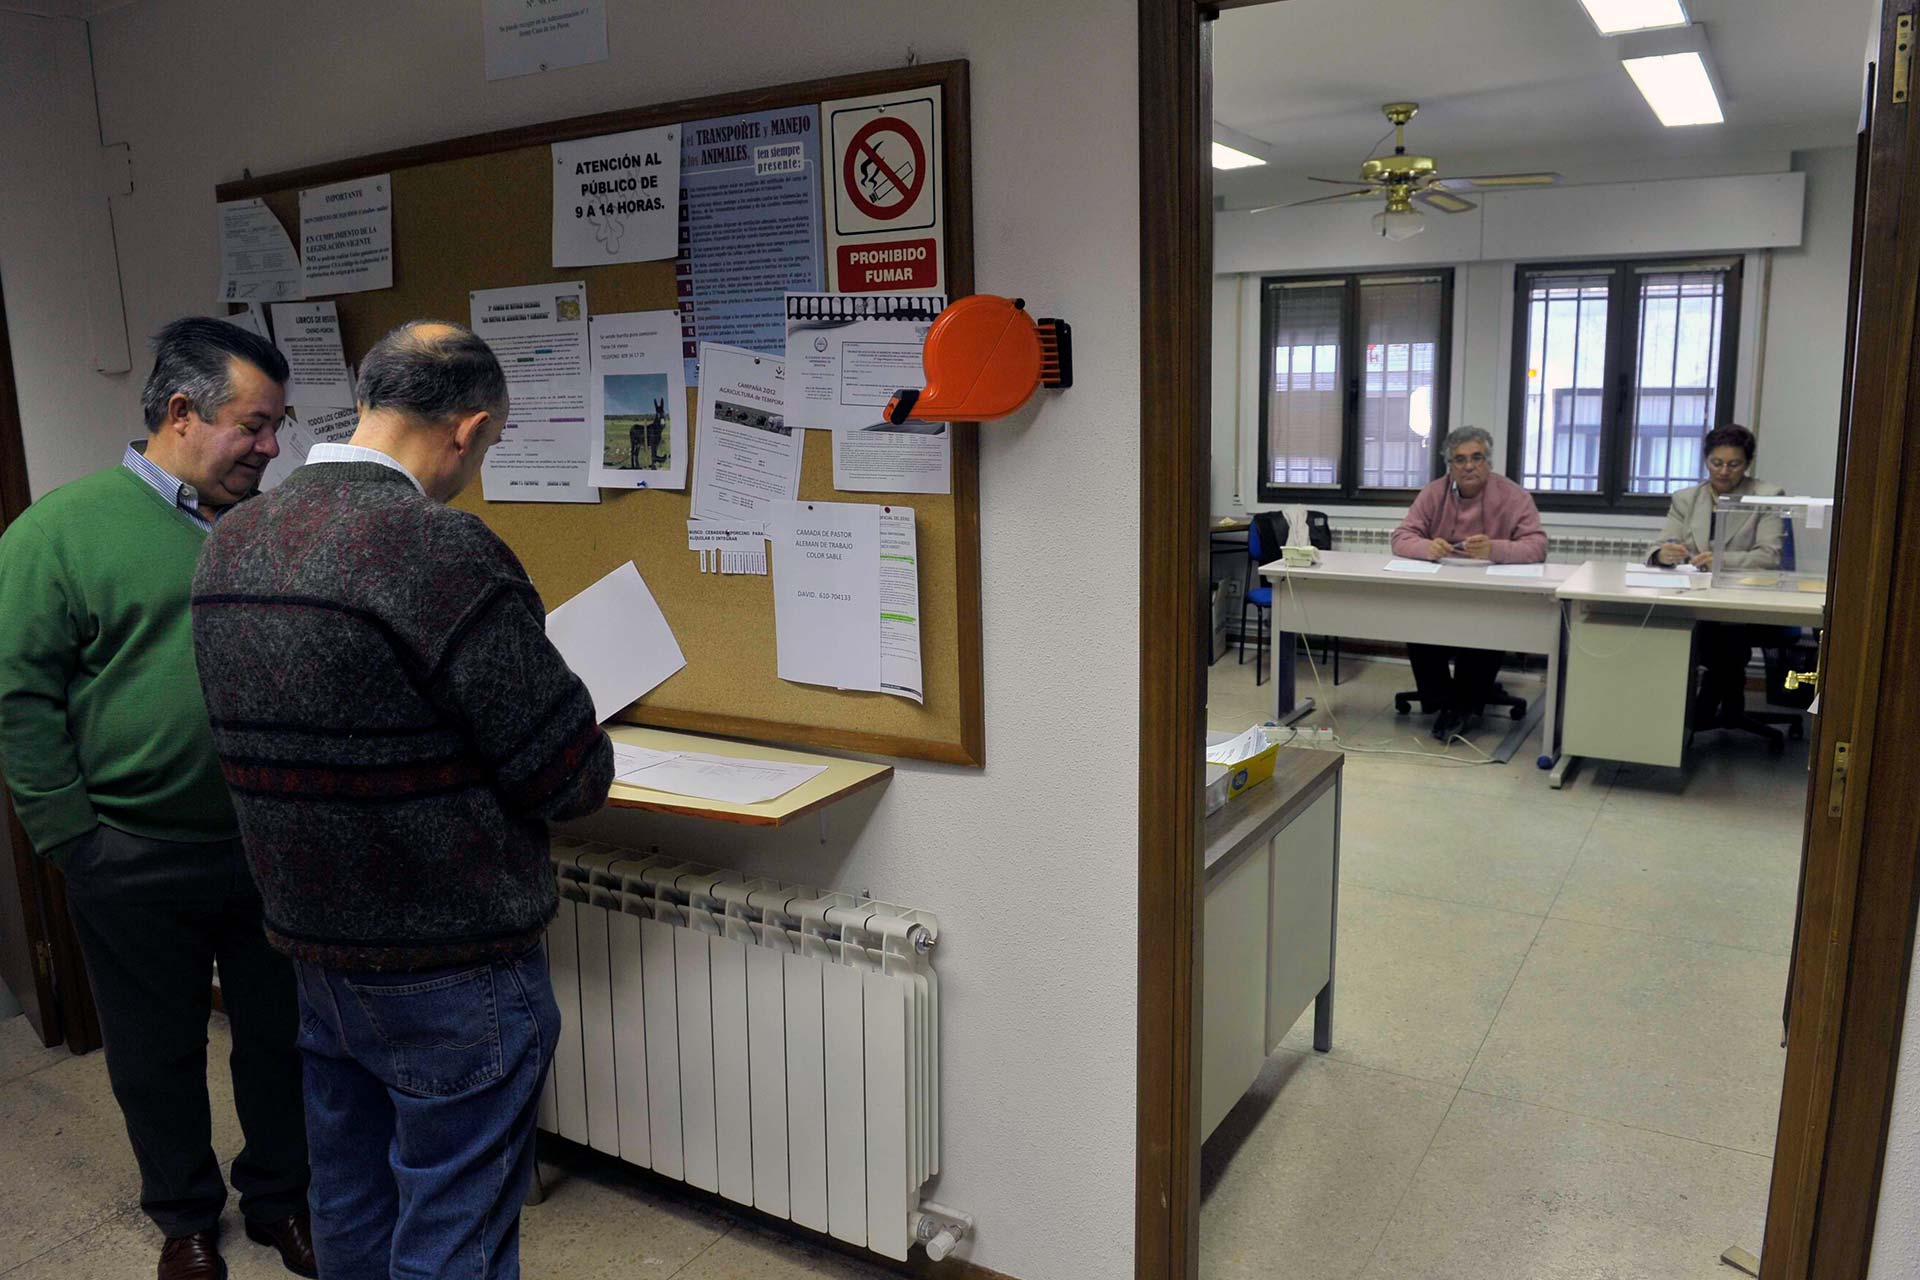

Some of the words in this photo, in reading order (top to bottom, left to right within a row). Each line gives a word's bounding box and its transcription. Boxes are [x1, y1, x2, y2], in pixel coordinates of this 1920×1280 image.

[696, 122, 761, 146] TRANSPORTE
[771, 115, 811, 136] MANEJO
[757, 148, 770, 160] ten
[770, 144, 800, 158] siempre
[575, 153, 640, 175] ATENCIÓN
[645, 152, 662, 166] AL
[757, 159, 801, 174] presente:
[581, 178, 637, 196] PÚBLICO
[641, 176, 658, 189] DE
[325, 189, 363, 204] IMPORTANTE
[575, 206, 583, 218] 9
[587, 205, 596, 217] A
[599, 203, 614, 216] 14
[618, 197, 665, 214] HORAS.
[369, 225, 377, 234] LA
[850, 247, 927, 265] PROHIBIDO
[865, 267, 913, 283] FUMAR
[719, 387, 754, 399] AGRICULTURA
[737, 382, 762, 392] CAMPAÑA
[796, 529, 821, 537] CAMADA
[829, 542, 853, 550] TRABAJO
